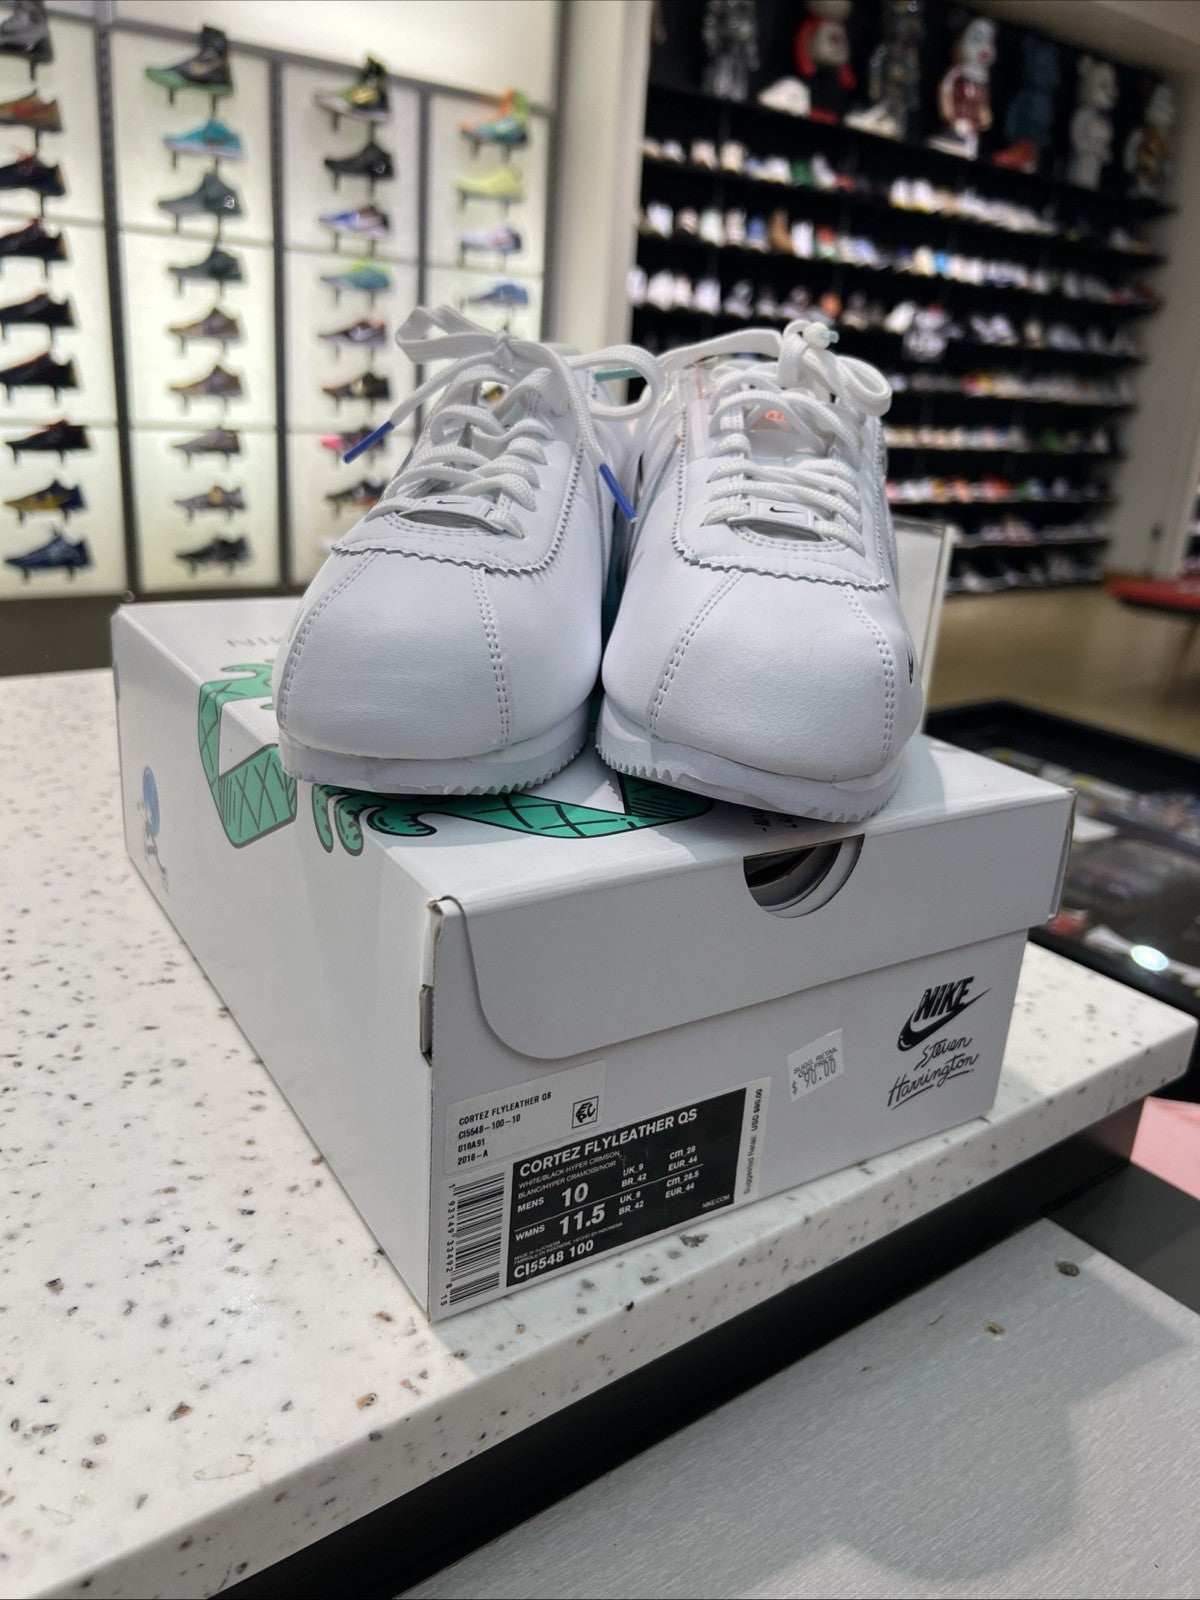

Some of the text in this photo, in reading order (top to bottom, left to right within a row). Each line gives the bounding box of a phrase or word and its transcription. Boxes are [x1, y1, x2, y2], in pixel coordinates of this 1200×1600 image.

[913, 975, 975, 1023] NIKE
[914, 1037, 973, 1071] Steven
[887, 1053, 979, 1107] Harrington
[458, 1109, 489, 1126] CORTEZ
[491, 1093, 540, 1117] FLYLEATHER
[751, 1114, 759, 1132] USD
[519, 1108, 698, 1177] CORTEZ FLYLEATHER QS
[517, 1182, 589, 1213] MENS 10
[702, 1193, 731, 1209] NIKE.COM
[515, 1203, 606, 1241] WMNS 11.5
[513, 1239, 594, 1278] CI5548 100
